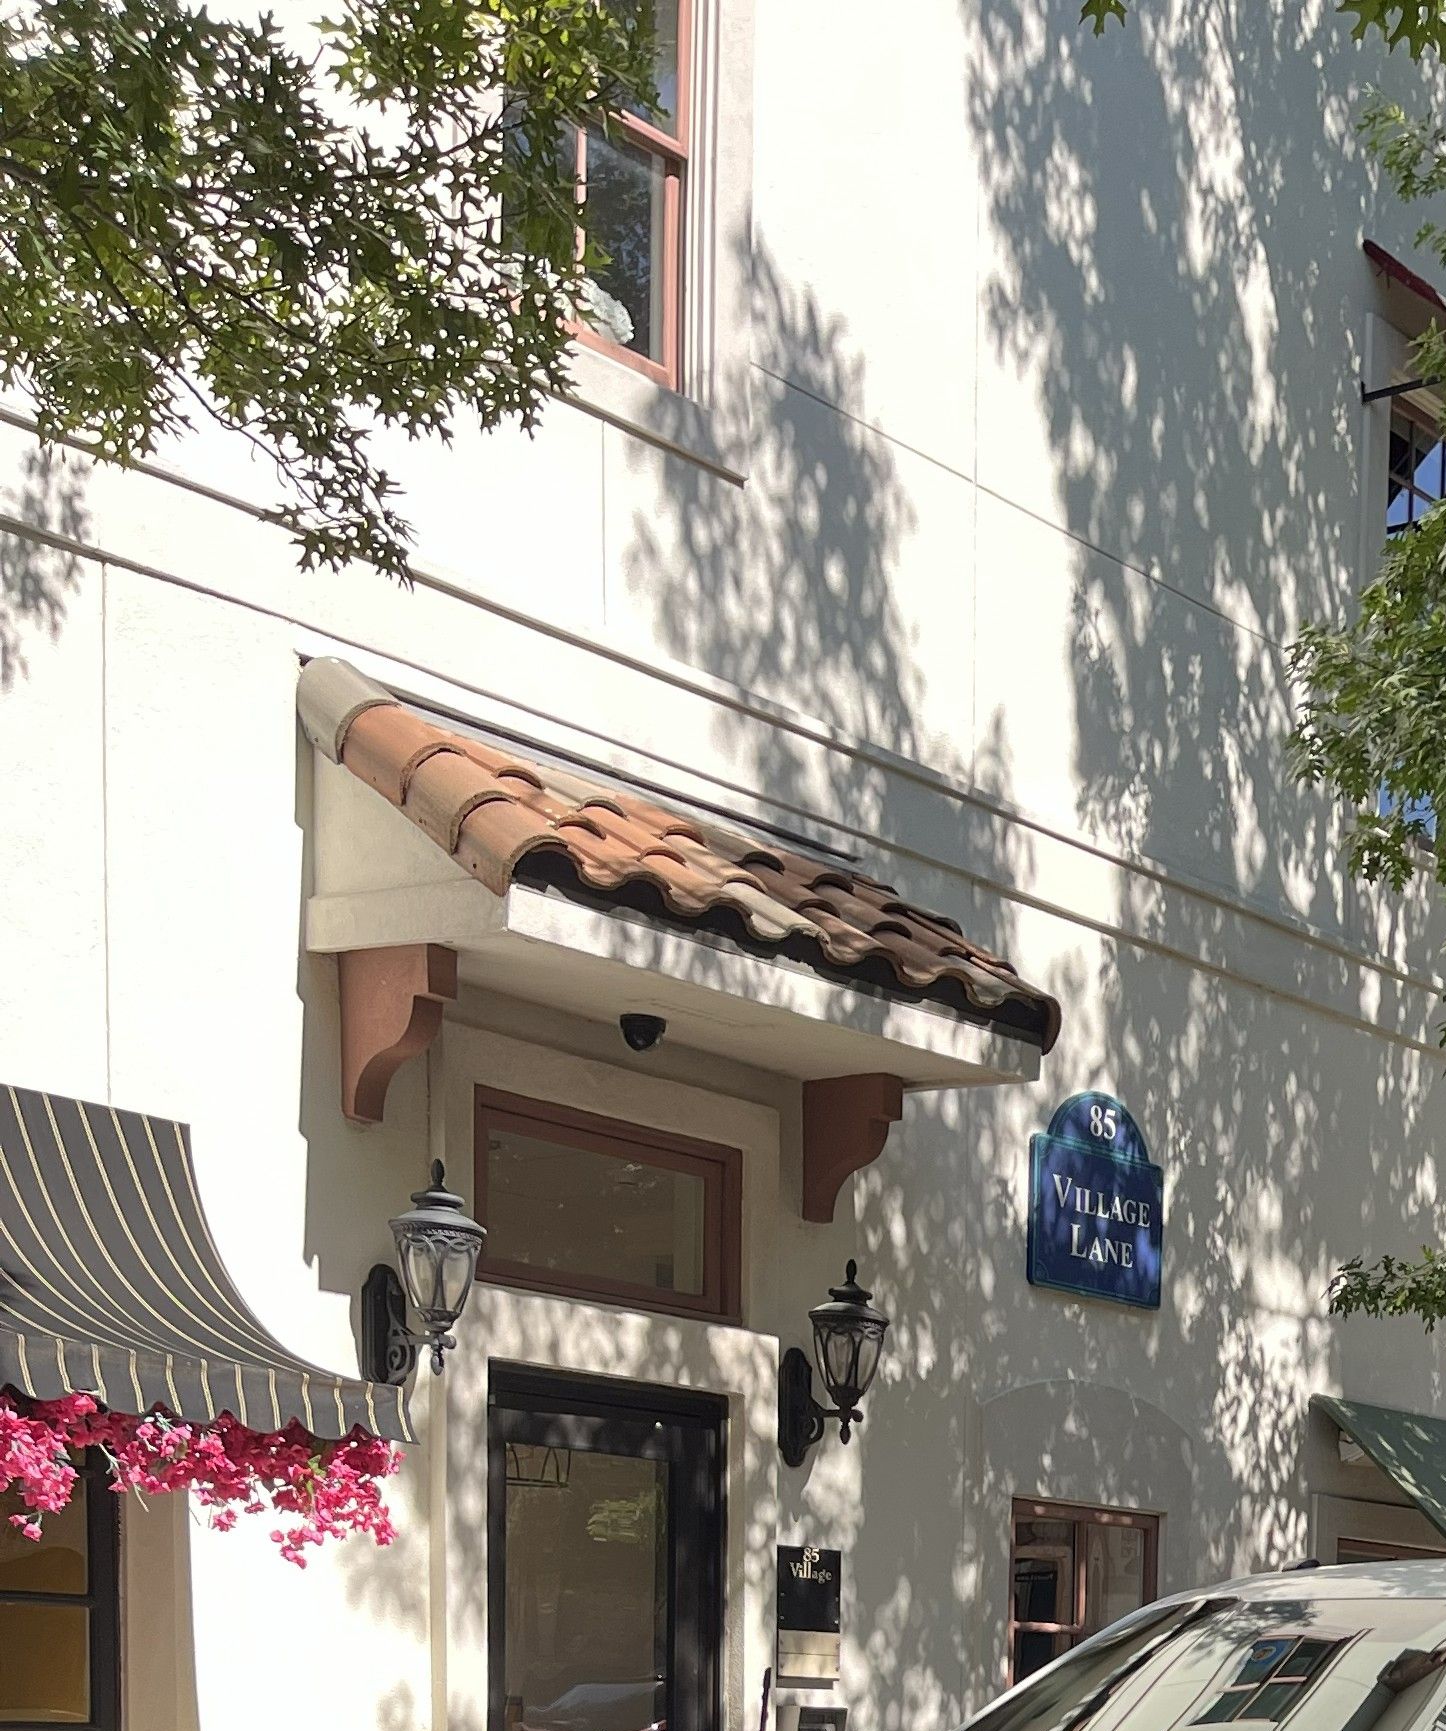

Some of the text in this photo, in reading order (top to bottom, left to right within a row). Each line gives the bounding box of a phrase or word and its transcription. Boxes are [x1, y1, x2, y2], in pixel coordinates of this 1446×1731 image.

[1090, 1105, 1117, 1140] 85
[1070, 1223, 1134, 1269] LANE
[803, 1547, 820, 1562] 85
[789, 1561, 833, 1584] Village
